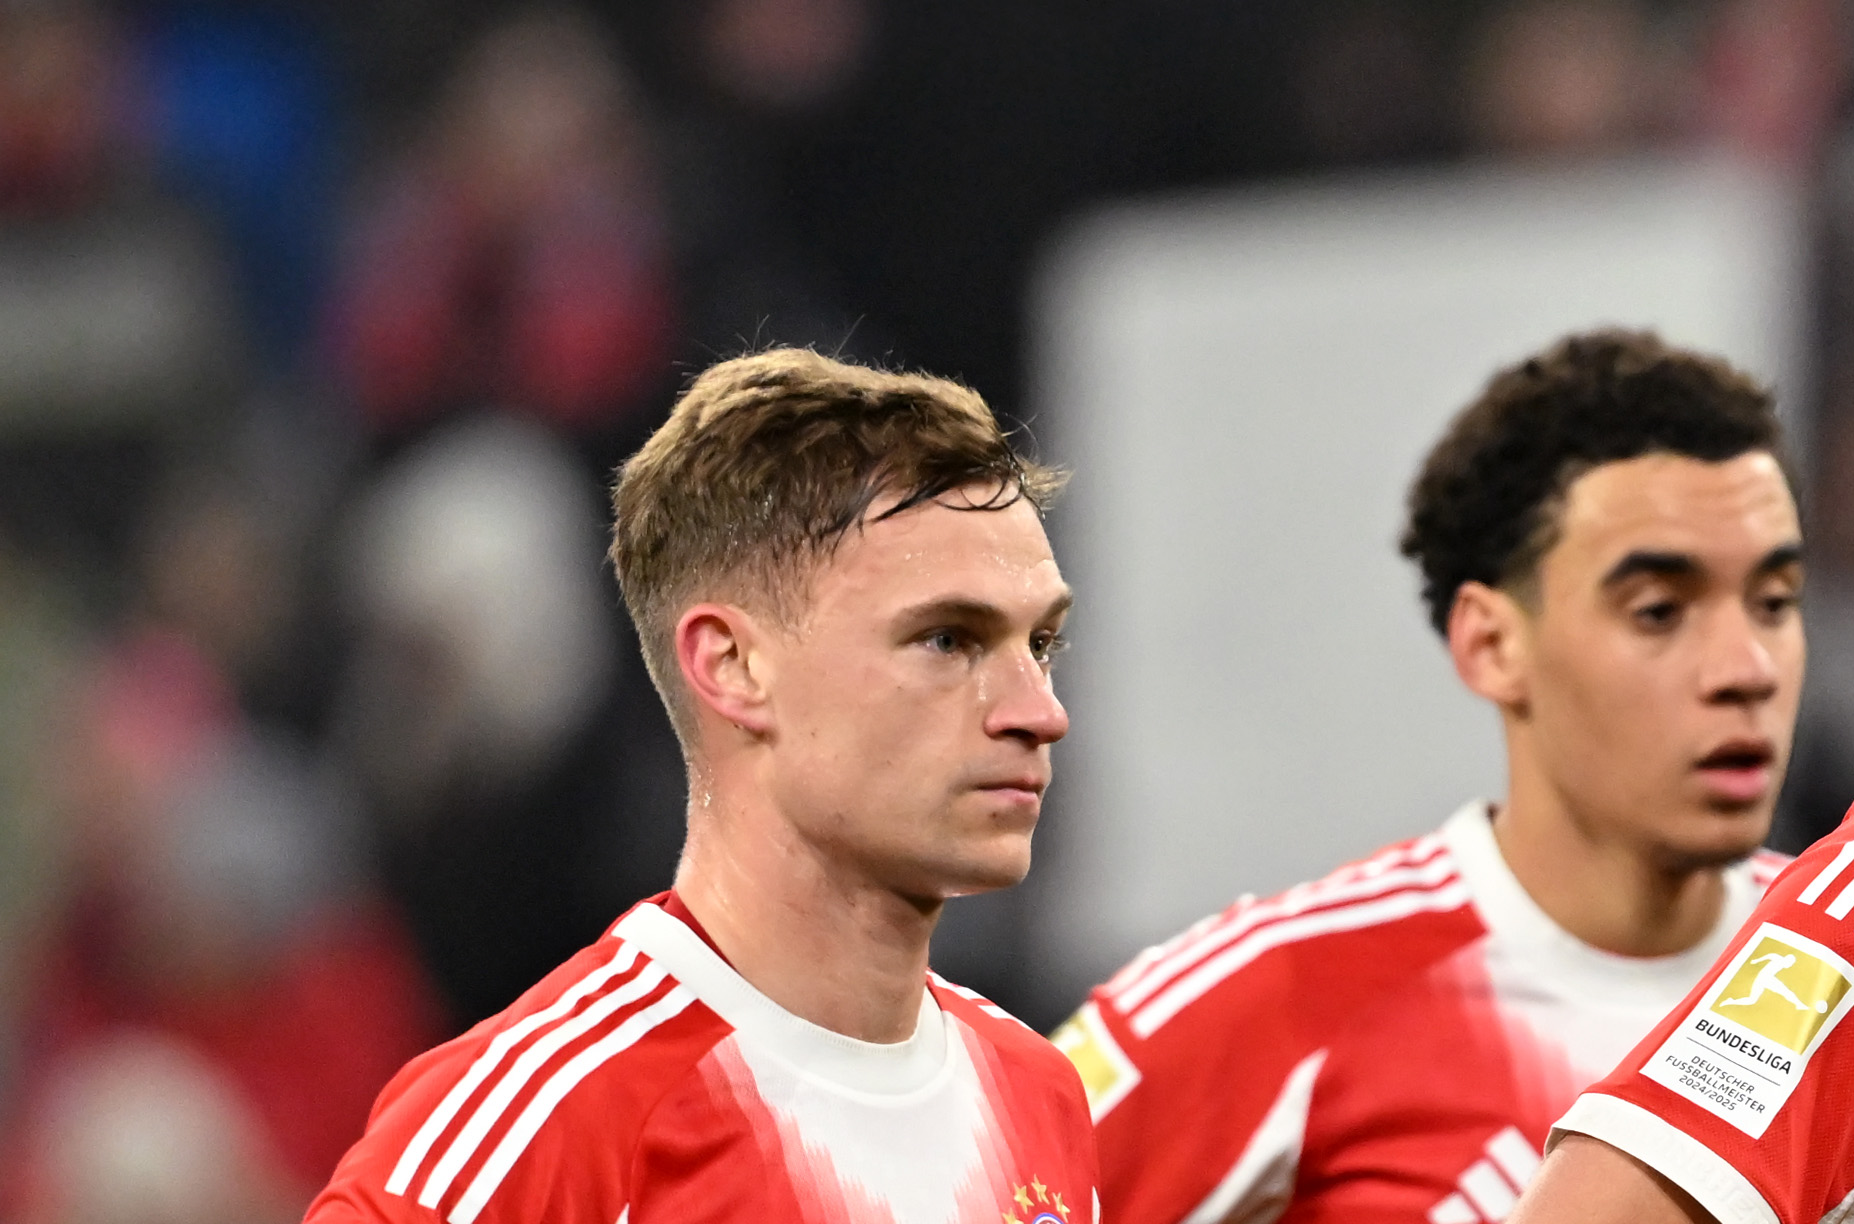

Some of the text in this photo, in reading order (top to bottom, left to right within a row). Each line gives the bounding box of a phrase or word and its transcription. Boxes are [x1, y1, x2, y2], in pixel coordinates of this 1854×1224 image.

[1695, 1019, 1792, 1074] BUNDESLIGA
[1665, 1055, 1766, 1114] FUSSBALLMEISTER
[1678, 1074, 1737, 1111] 2024/2025
[1690, 1055, 1755, 1093] DEUTSCHER
